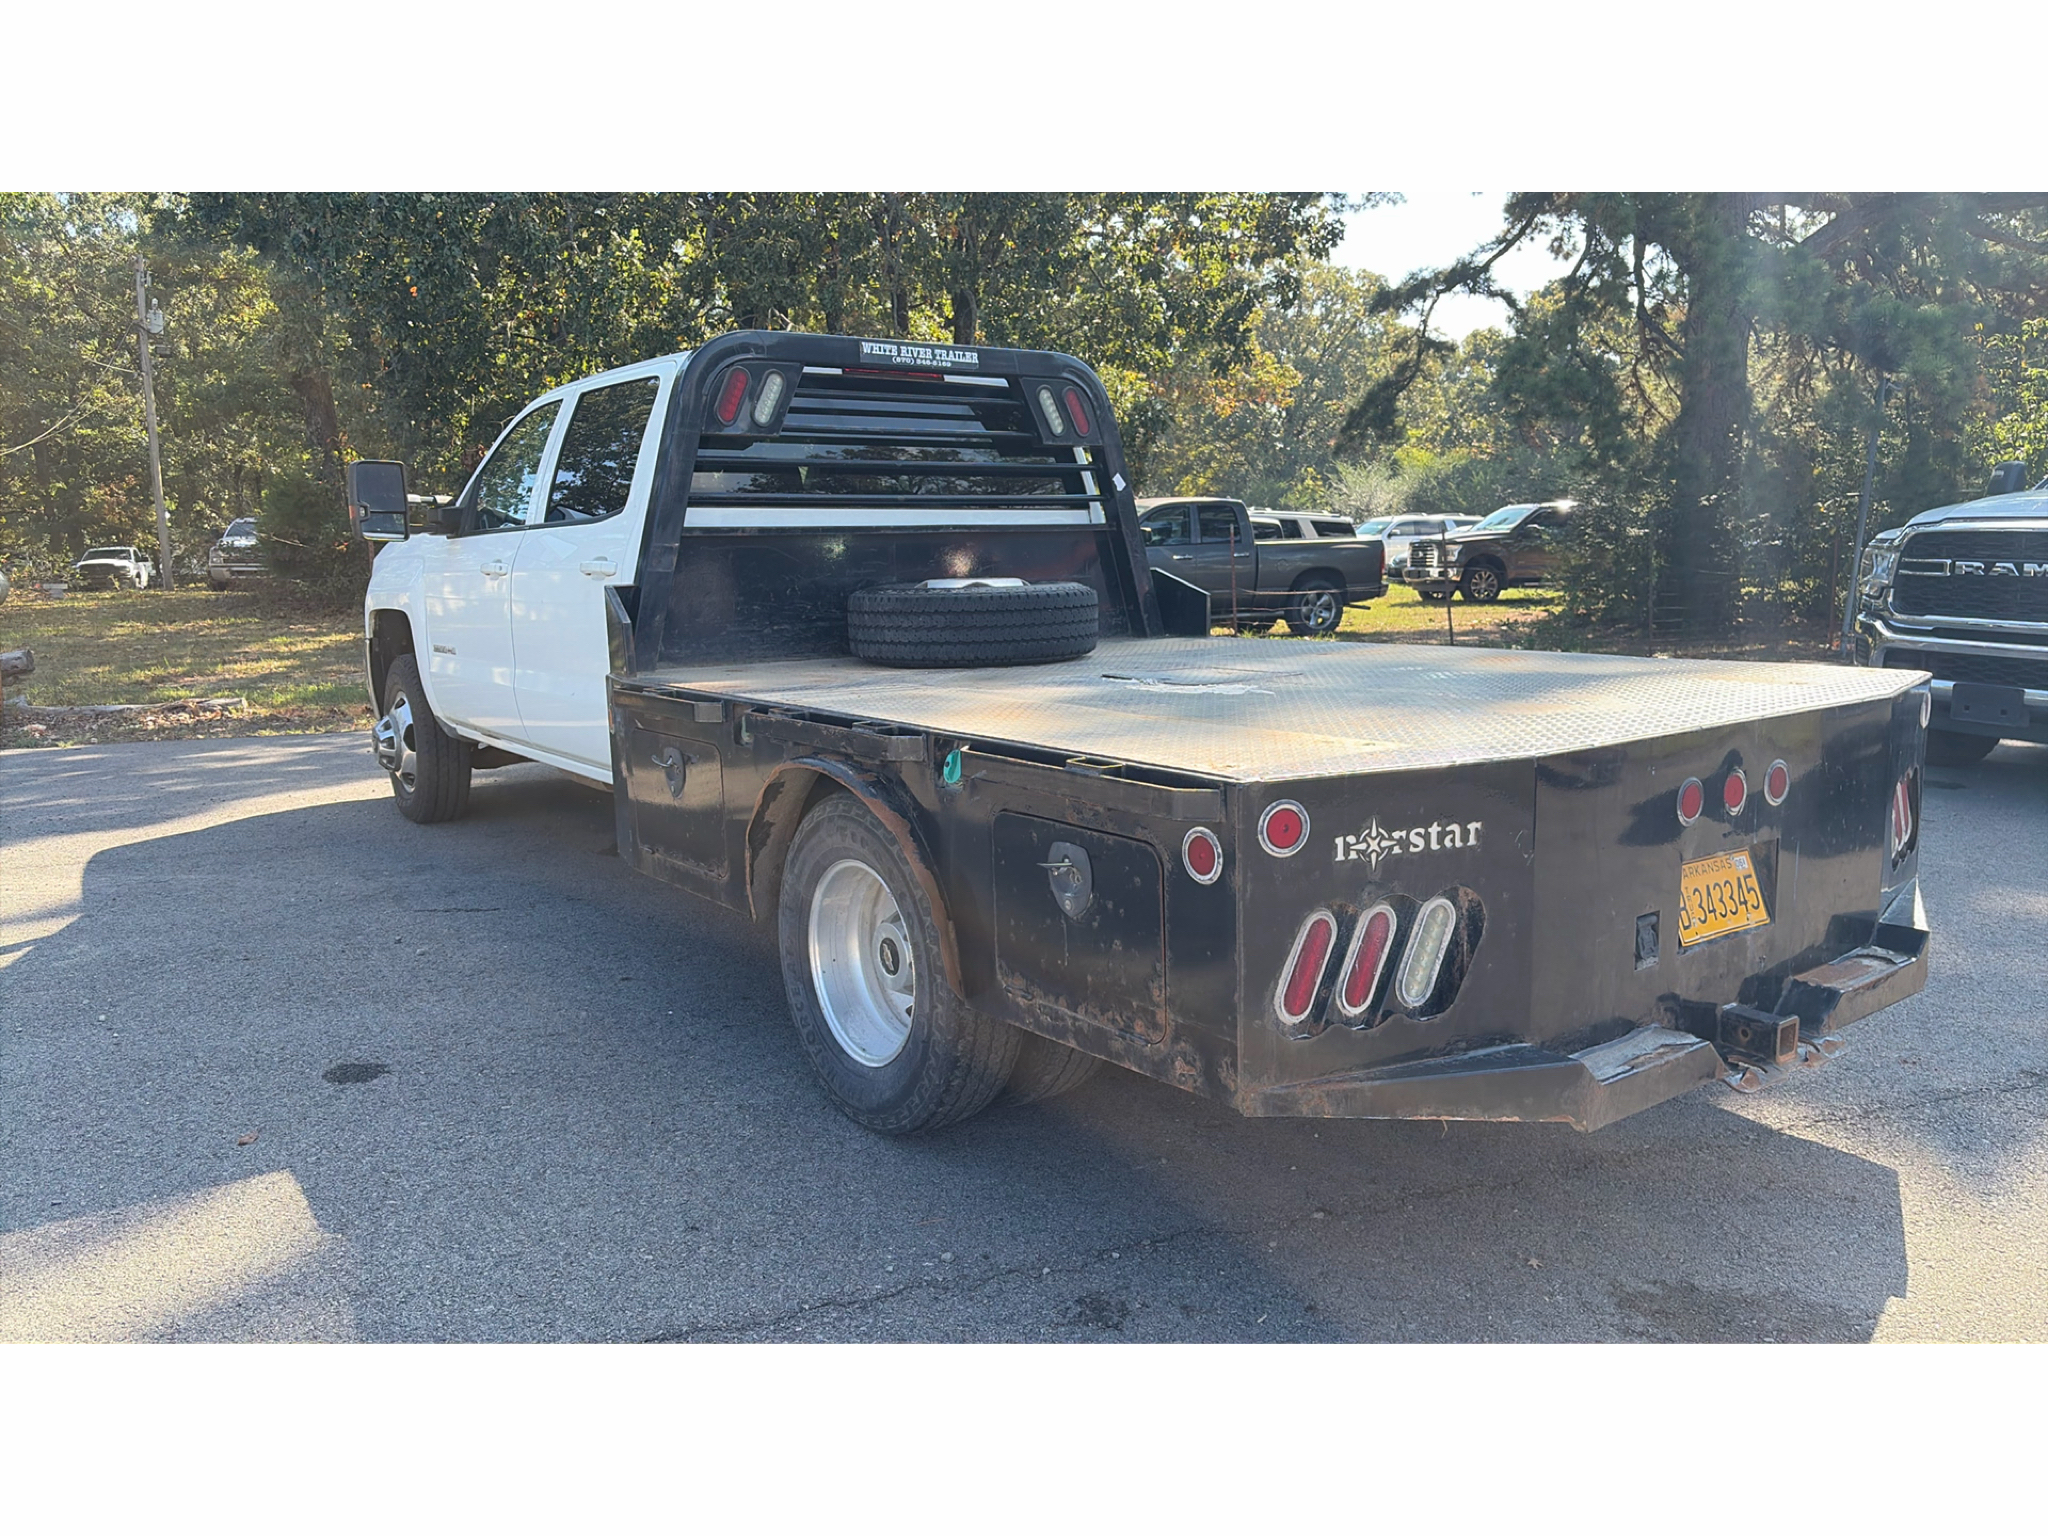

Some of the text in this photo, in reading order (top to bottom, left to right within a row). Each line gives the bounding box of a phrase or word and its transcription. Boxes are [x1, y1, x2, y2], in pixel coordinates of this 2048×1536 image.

[861, 342, 979, 363] WHITE RIVER TRAILER
[1954, 561, 2048, 577] RAM
[1682, 858, 1733, 880] ARKANSAS
